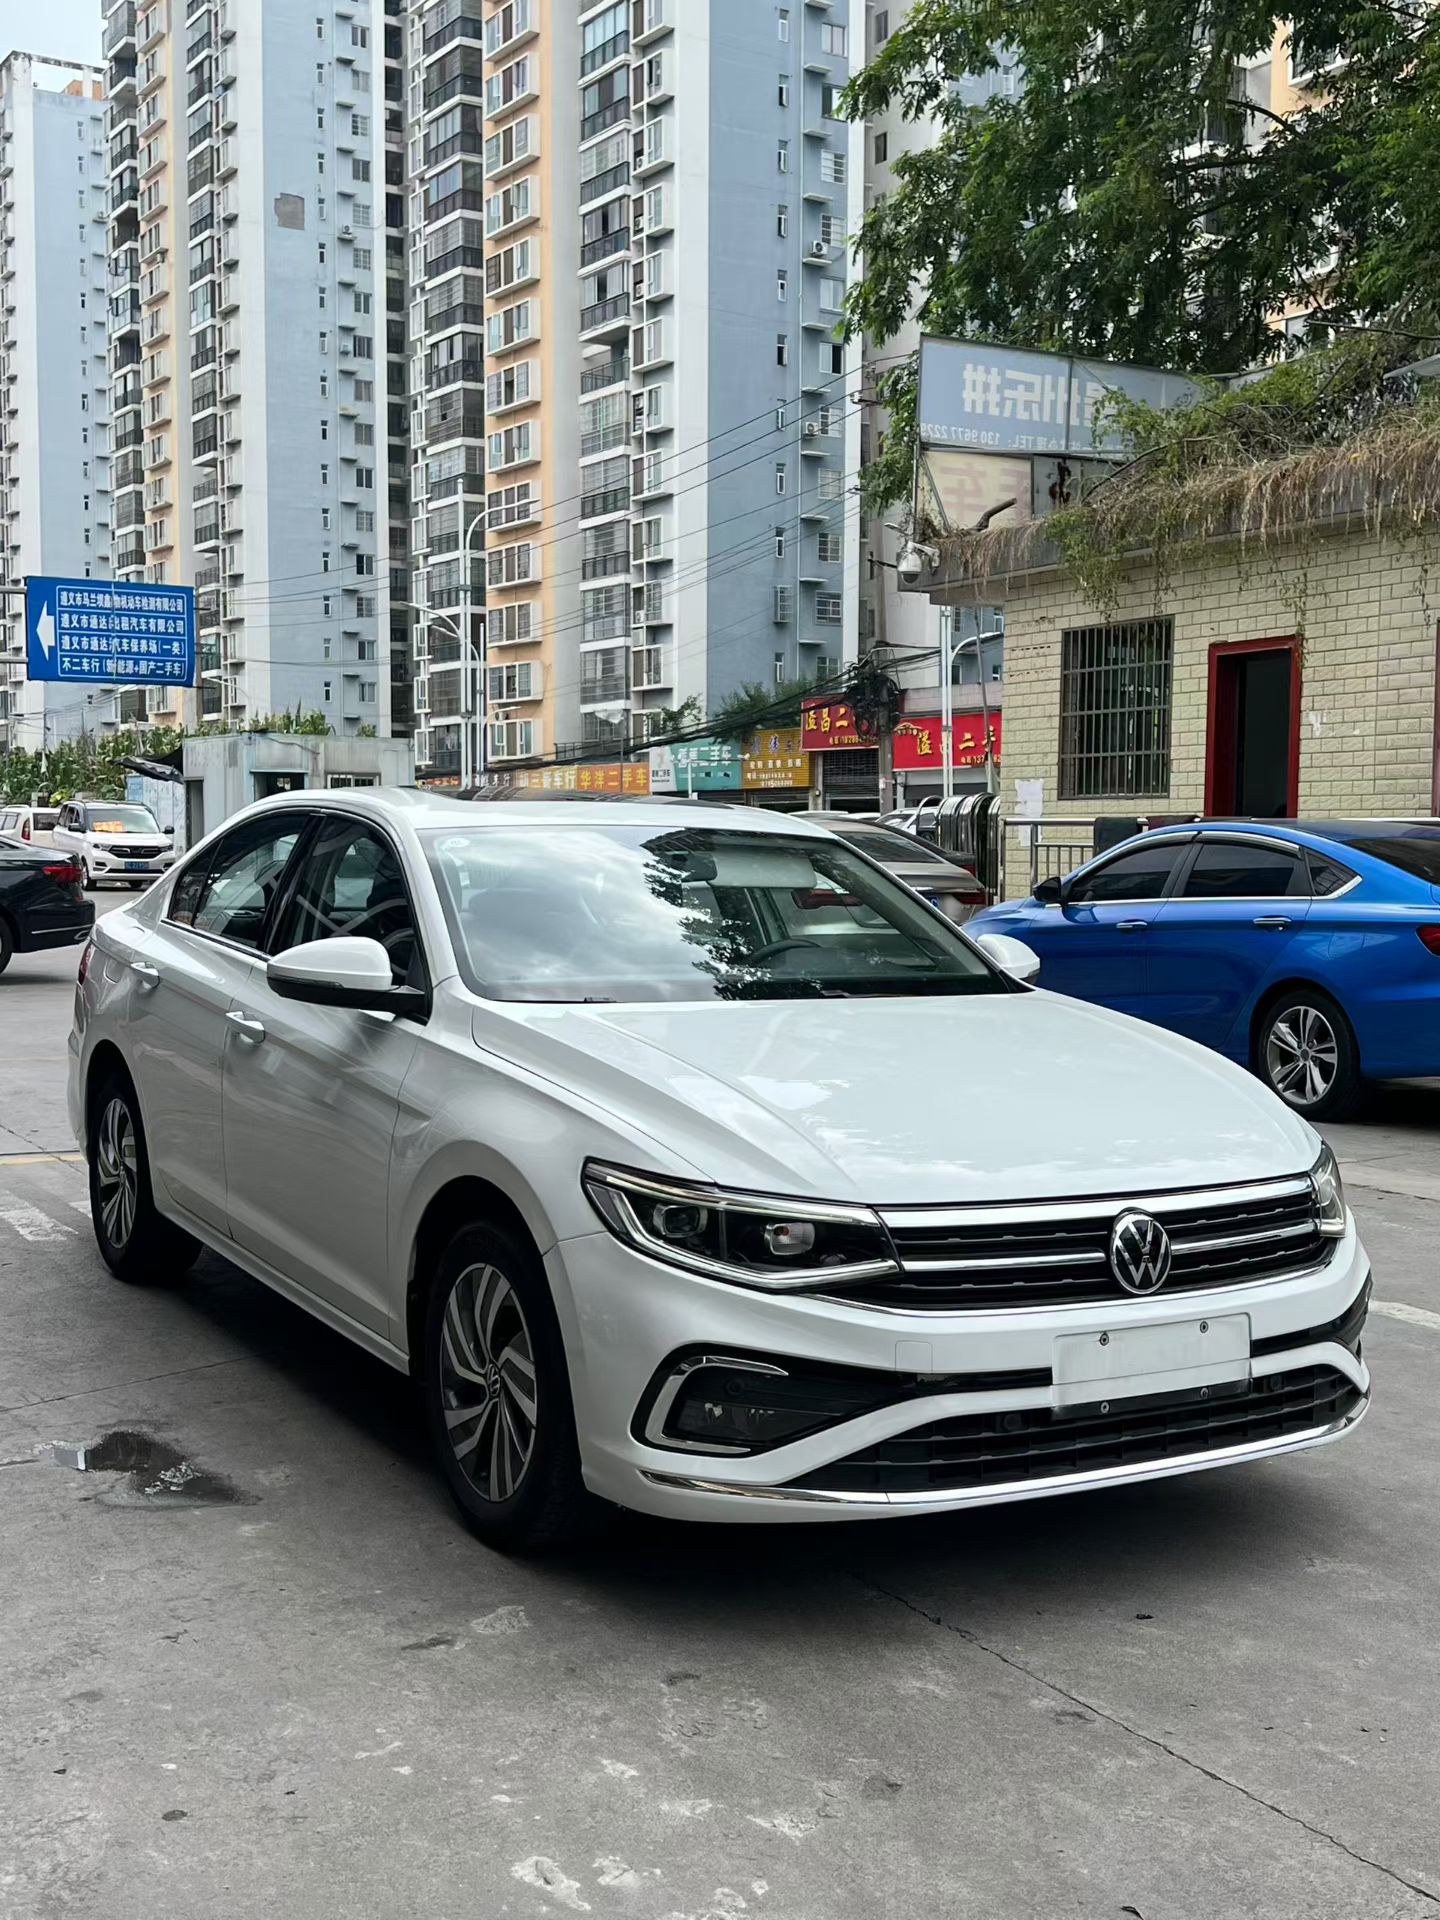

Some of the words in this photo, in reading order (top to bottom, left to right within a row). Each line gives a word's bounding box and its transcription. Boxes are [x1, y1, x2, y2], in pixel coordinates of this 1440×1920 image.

[580, 767, 648, 790] 华洋二手车
